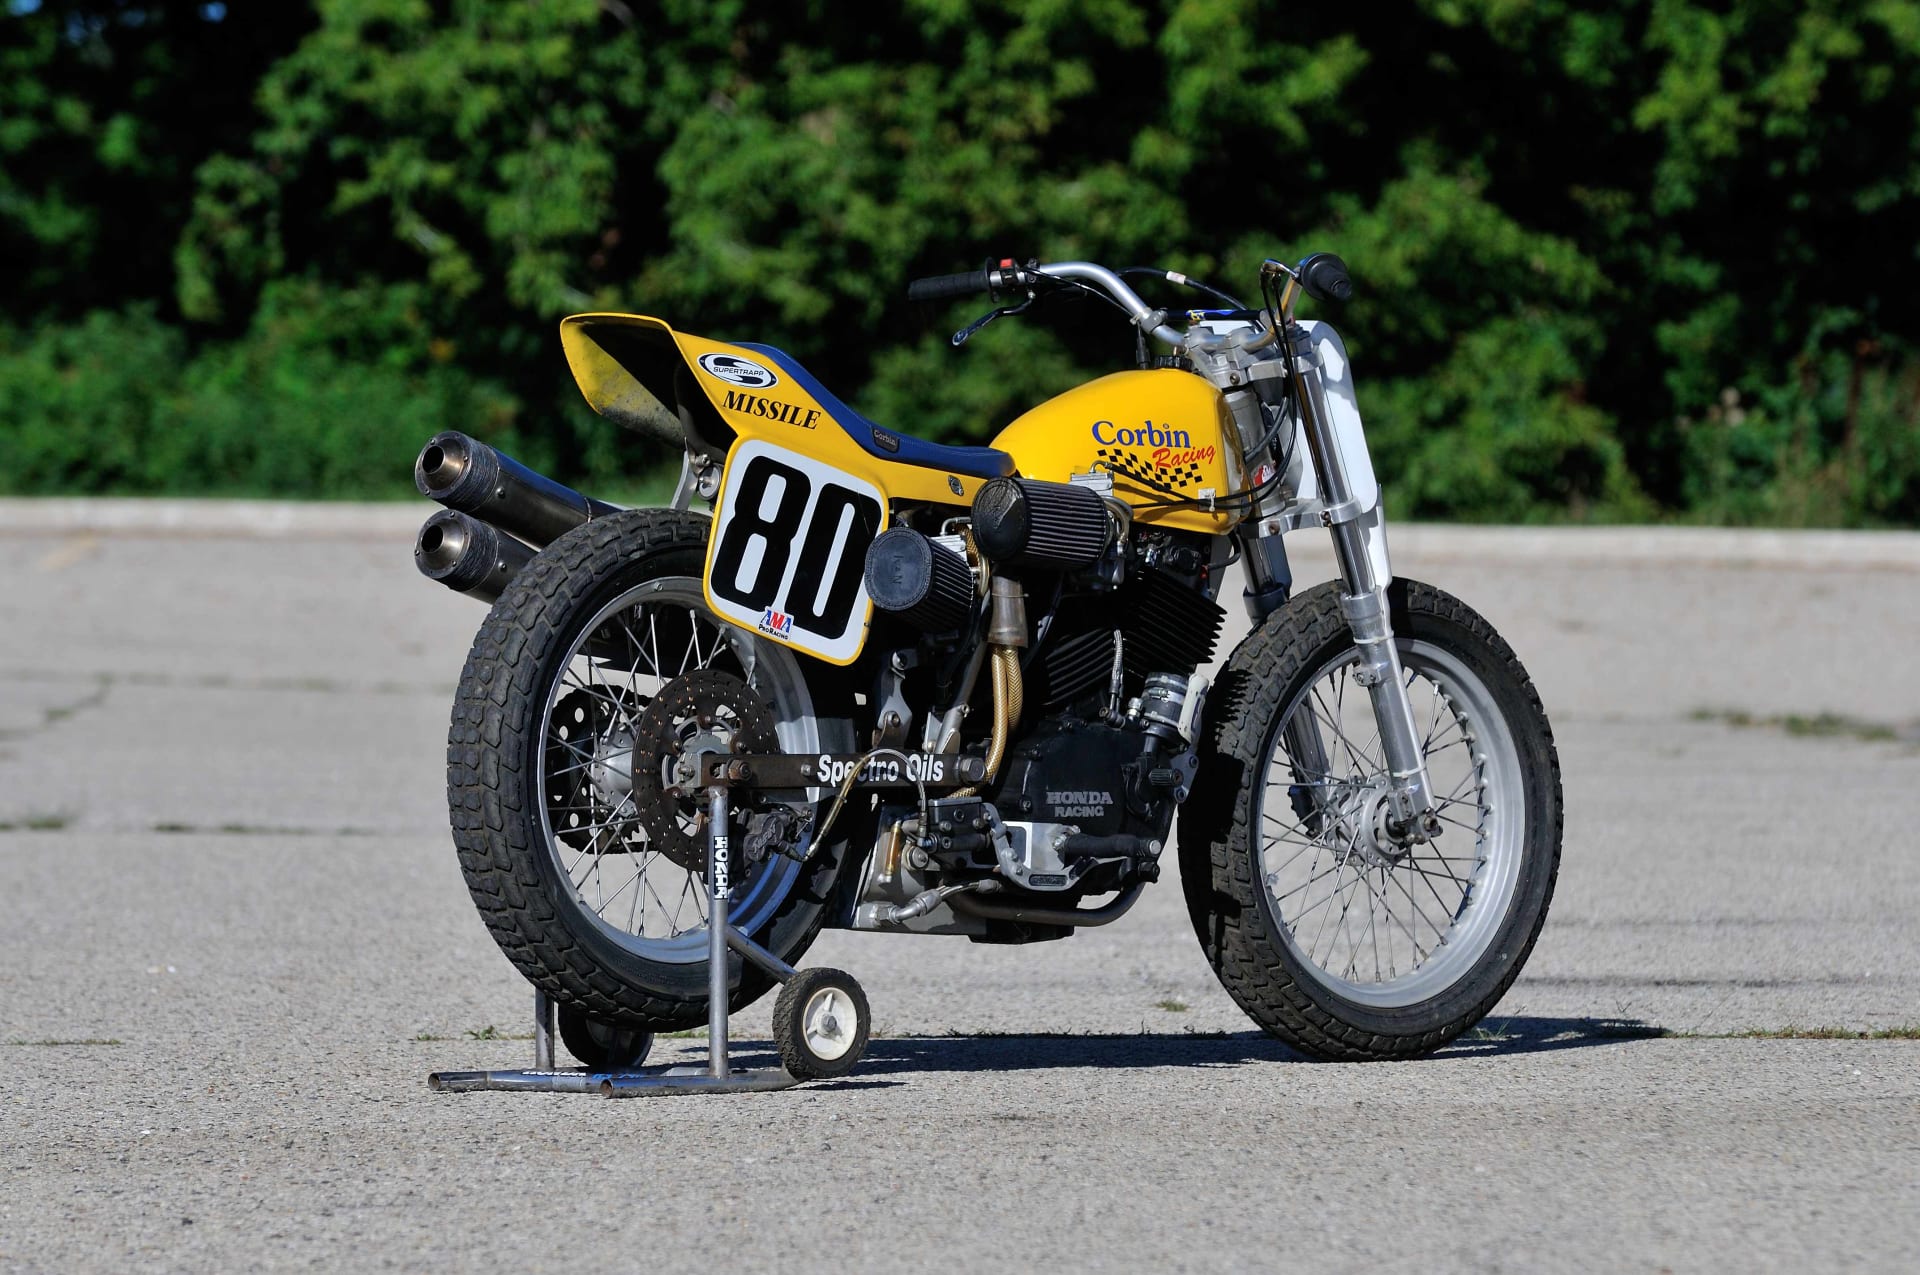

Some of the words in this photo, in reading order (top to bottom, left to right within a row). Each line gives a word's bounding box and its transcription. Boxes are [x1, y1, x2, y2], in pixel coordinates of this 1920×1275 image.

[713, 366, 765, 376] SUPERTRAPP
[722, 390, 821, 429] MISSILE
[874, 429, 896, 446] Corbin
[1091, 420, 1191, 448] Corbin
[1152, 444, 1216, 471] Racing
[710, 455, 882, 640] 80
[760, 609, 792, 633] AMA
[817, 754, 899, 788] Spectro
[906, 753, 944, 782] Oils
[1046, 791, 1114, 805] HONDA
[1054, 805, 1105, 818] RACING
[714, 836, 729, 899] HONDA
